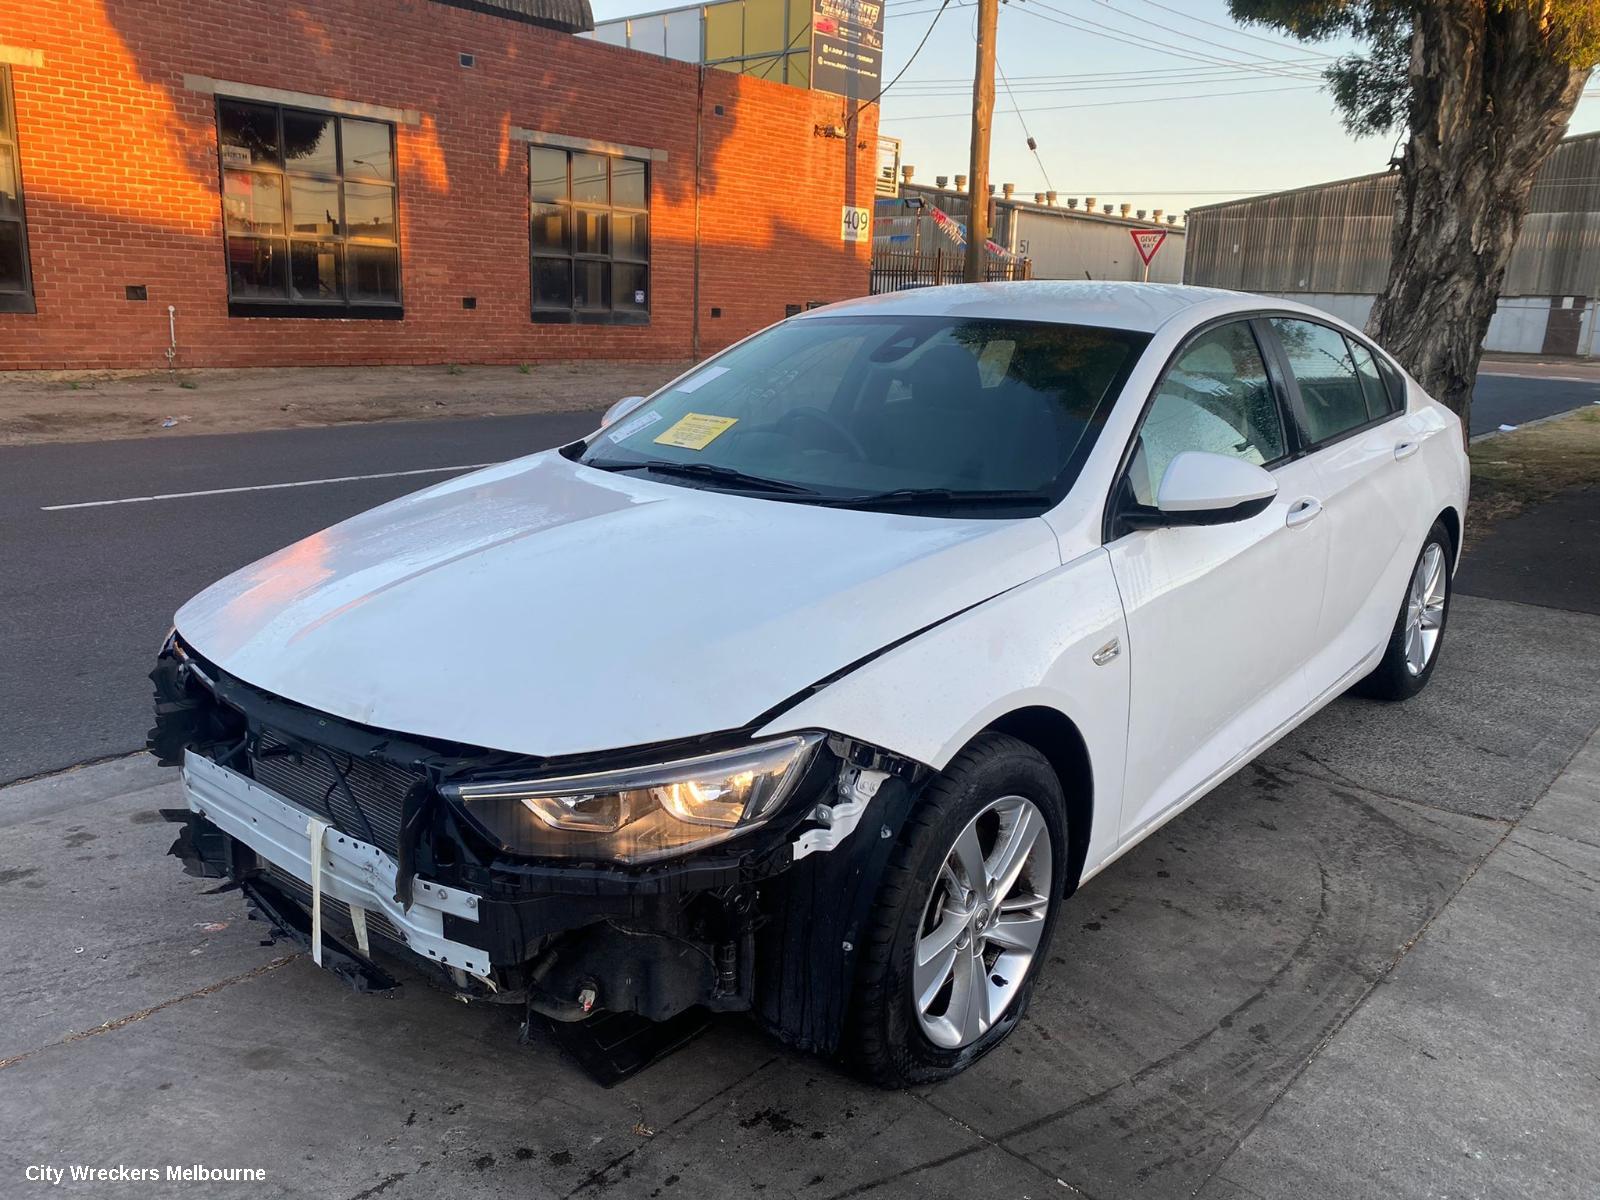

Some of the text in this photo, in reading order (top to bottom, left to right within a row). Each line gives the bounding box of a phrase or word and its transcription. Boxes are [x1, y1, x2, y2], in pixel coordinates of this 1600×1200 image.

[843, 210, 868, 231] 409
[1019, 239, 1030, 254] 51
[1140, 235, 1158, 243] GIVE
